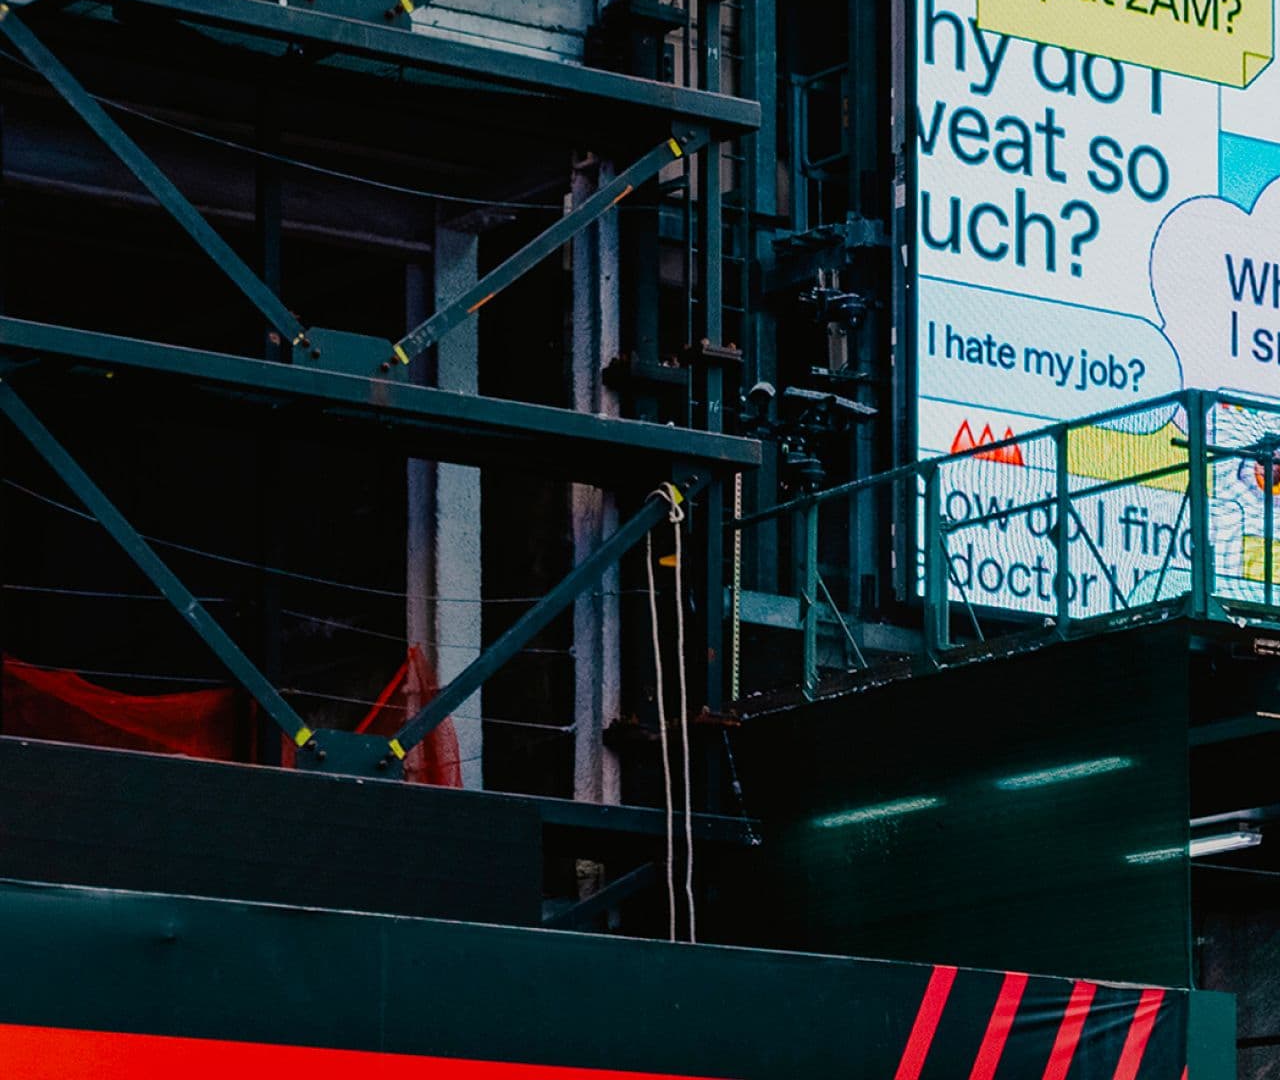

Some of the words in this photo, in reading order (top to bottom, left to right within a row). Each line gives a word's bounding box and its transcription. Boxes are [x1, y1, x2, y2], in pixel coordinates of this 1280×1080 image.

[1086, 134, 1170, 204] so
[921, 187, 1101, 279] uch?
[928, 321, 936, 357] I
[945, 323, 1017, 373] hate
[1023, 346, 1081, 389] my
[1074, 348, 1147, 394] job?
[1230, 310, 1240, 359] I
